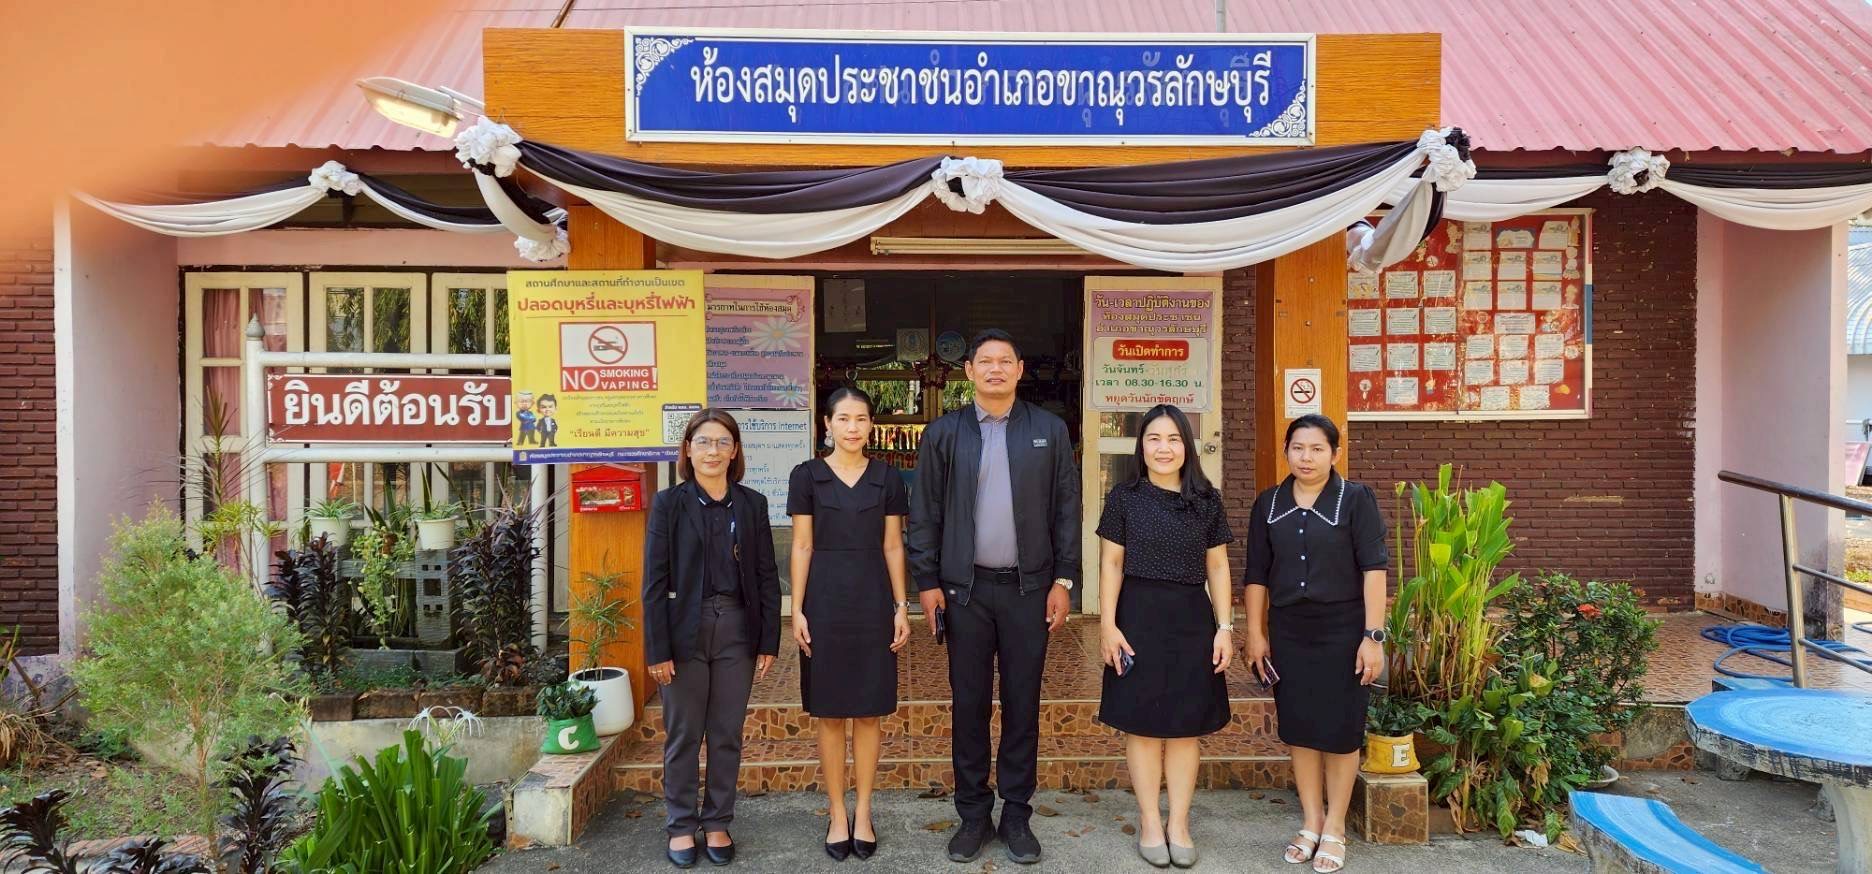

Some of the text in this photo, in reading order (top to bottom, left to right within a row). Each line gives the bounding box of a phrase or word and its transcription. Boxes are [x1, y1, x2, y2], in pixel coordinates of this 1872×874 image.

[525, 276, 685, 288] สถานศึกษาและสถานที่ทำงานเป็นเขต
[517, 291, 695, 315] ปลอดบุหรี่และบุหรี่ไฟฟ้า
[1096, 294, 1210, 311] วัน-เวลาปฏิบัติงานของ
[1103, 311, 1201, 324] ห้องสมุดประชาชน
[1117, 343, 1184, 357] วันเปิดทำการ
[562, 369, 649, 391] NO SMOKING
[1095, 379, 1119, 387] เวลา
[284, 379, 512, 426] ยินดีต้อนรับ
[1105, 393, 1195, 406] หยุดวันนักขัตฤกษ์
[558, 725, 580, 750] C
[1392, 743, 1410, 767] E
